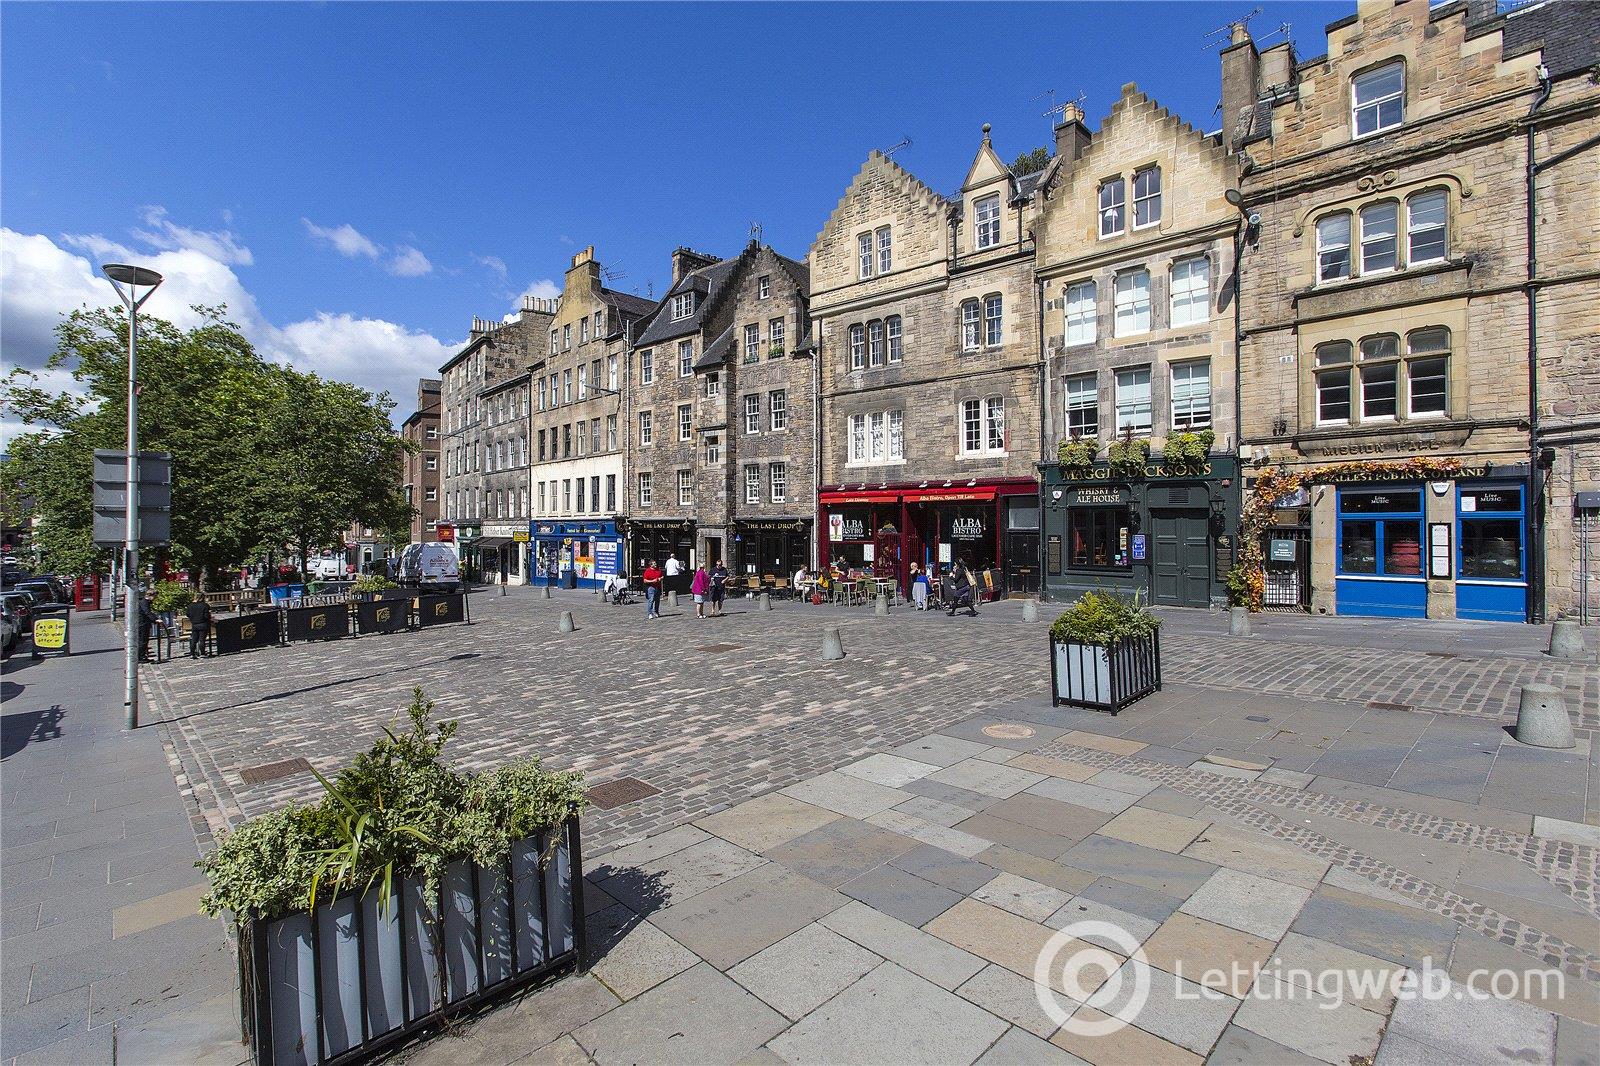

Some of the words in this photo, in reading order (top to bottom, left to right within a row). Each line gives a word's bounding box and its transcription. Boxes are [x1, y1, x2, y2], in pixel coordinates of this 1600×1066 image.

[1322, 443, 1384, 456] MISSION
[1395, 438, 1440, 452] HALL
[1077, 487, 1110, 495] WHISKY
[1076, 495, 1091, 503] ALE
[1092, 494, 1120, 503] HOUSE
[952, 517, 982, 528] ALBA
[953, 527, 982, 535] BISTRO
